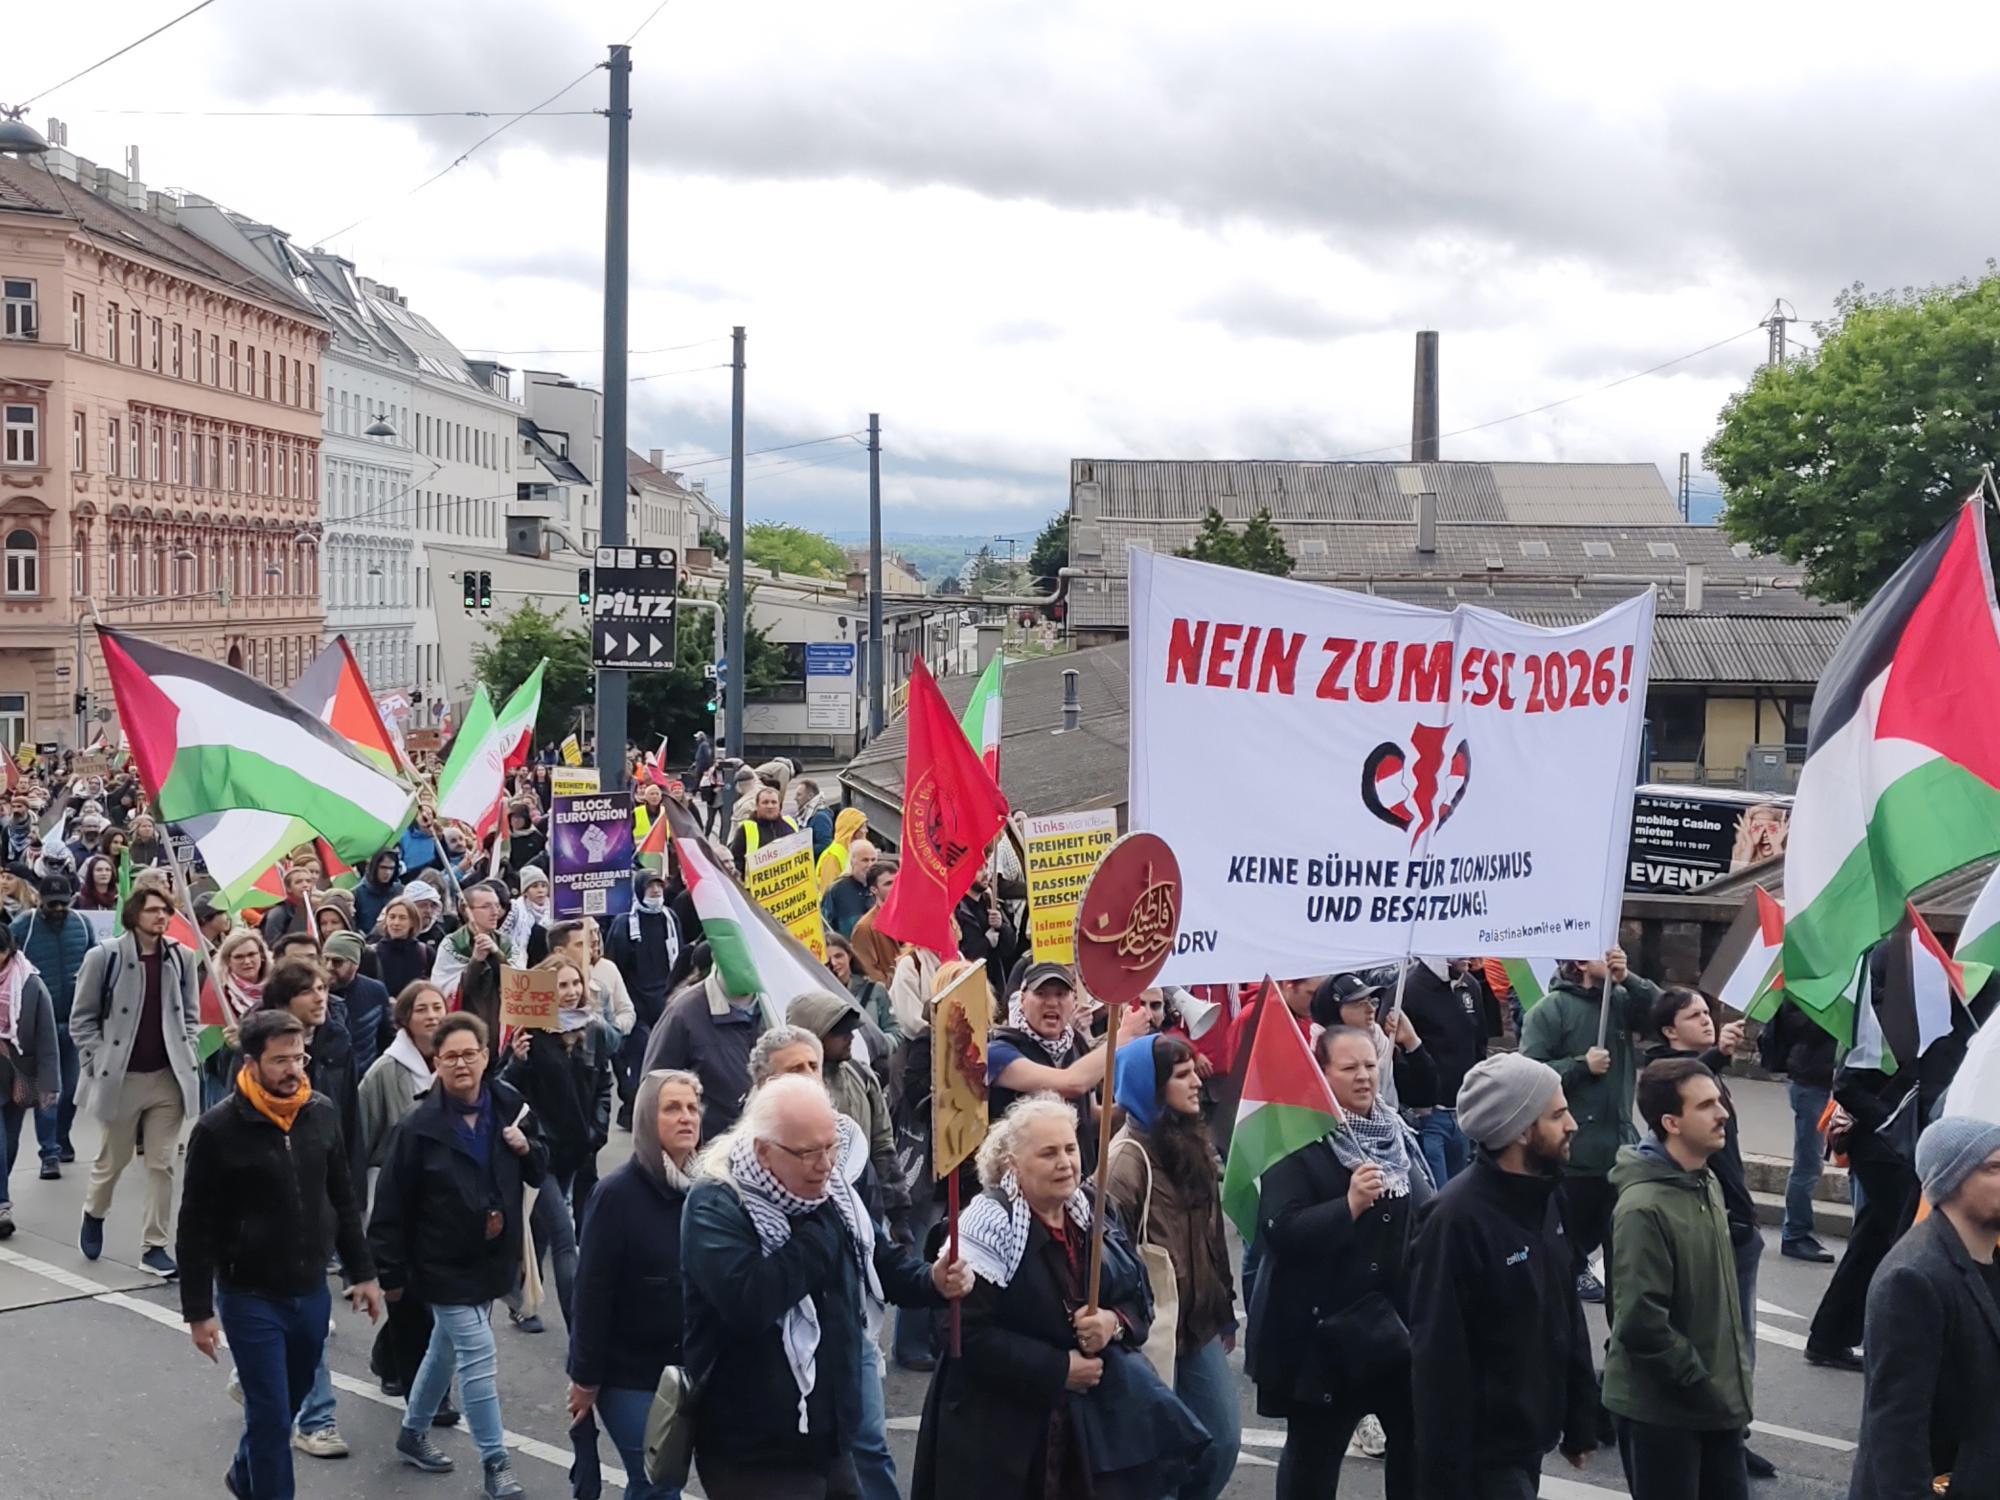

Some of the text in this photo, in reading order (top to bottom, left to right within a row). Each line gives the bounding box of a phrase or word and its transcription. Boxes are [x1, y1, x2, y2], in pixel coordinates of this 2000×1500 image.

[1166, 618, 1634, 713] NEIN ZUM ESC 2026!
[572, 799, 612, 812] BLOCK
[555, 809, 627, 824] EUROVISION
[1635, 814, 1721, 831] mobiles Casino
[1634, 825, 1674, 838] mieten
[1028, 830, 1112, 854] FREIHEIT FÜR
[752, 851, 811, 885] FREIHEIT FÜR
[1030, 850, 1103, 870] PALÄSTINA
[555, 869, 631, 884] DON'T CELEBRATE
[1227, 851, 1533, 890] KEINE BÜHNE FÜR ZIONISMUS
[570, 879, 616, 890] GENOCIDE
[754, 867, 809, 901] PALÄSTINA!
[1032, 873, 1091, 892] RASSISM
[765, 890, 807, 915] SSISMUS
[1033, 890, 1083, 907] ZERSCH
[1307, 890, 1488, 922] UND BESATZUNG!
[777, 900, 817, 925] CHLAGEN
[1478, 917, 1591, 943] Palästinakomitee Wien
[1036, 935, 1074, 948] bekäm
[512, 974, 531, 991] NO
